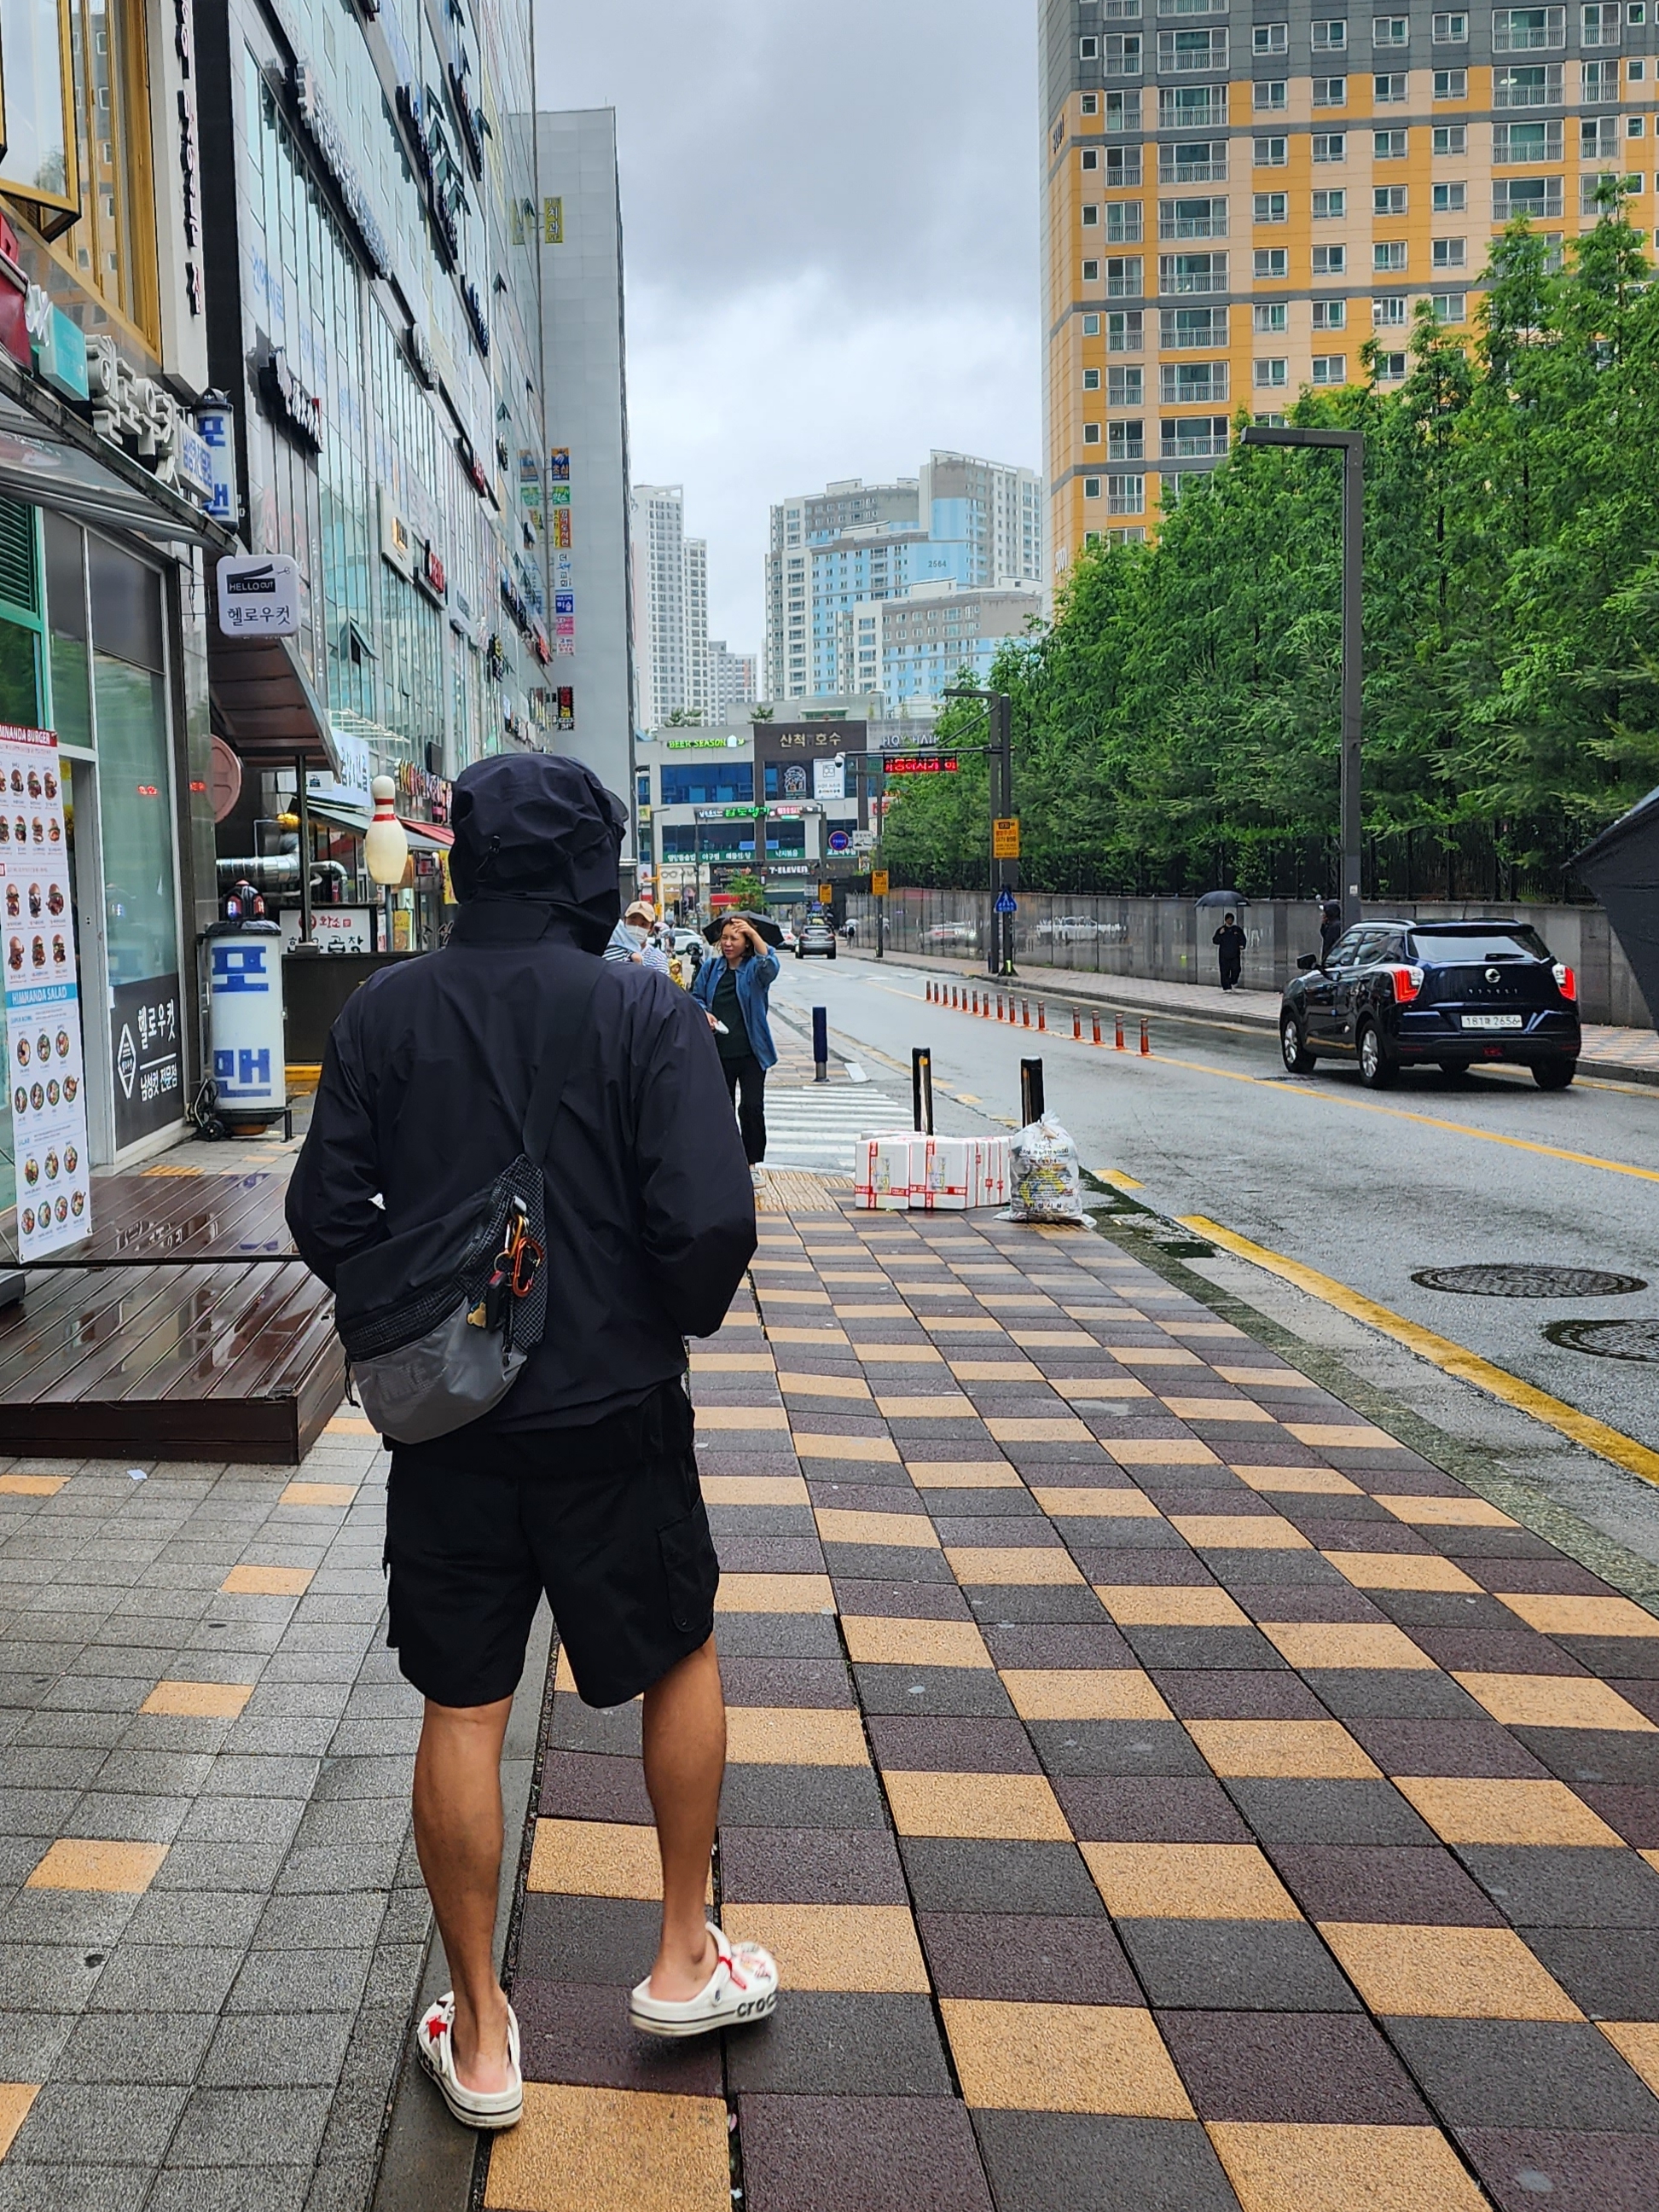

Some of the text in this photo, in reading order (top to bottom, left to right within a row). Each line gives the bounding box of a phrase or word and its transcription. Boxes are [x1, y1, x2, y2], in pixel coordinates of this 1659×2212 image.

[547, 206, 560, 235] 치과
[84, 334, 184, 497] 헬로우컷
[229, 583, 259, 591] HELLO
[227, 605, 291, 626] 헬로우컷
[26, 729, 50, 745] BURGER
[669, 738, 726, 748] BEER SEASON
[780, 732, 842, 748] 산척 호수
[11, 985, 67, 1006] HIMNANDA SALAD
[137, 998, 176, 1050] 헬로우컷
[212, 946, 271, 1098] 포맨
[140, 1073, 160, 1102] 남성컷
[160, 1062, 177, 1094] 전문점
